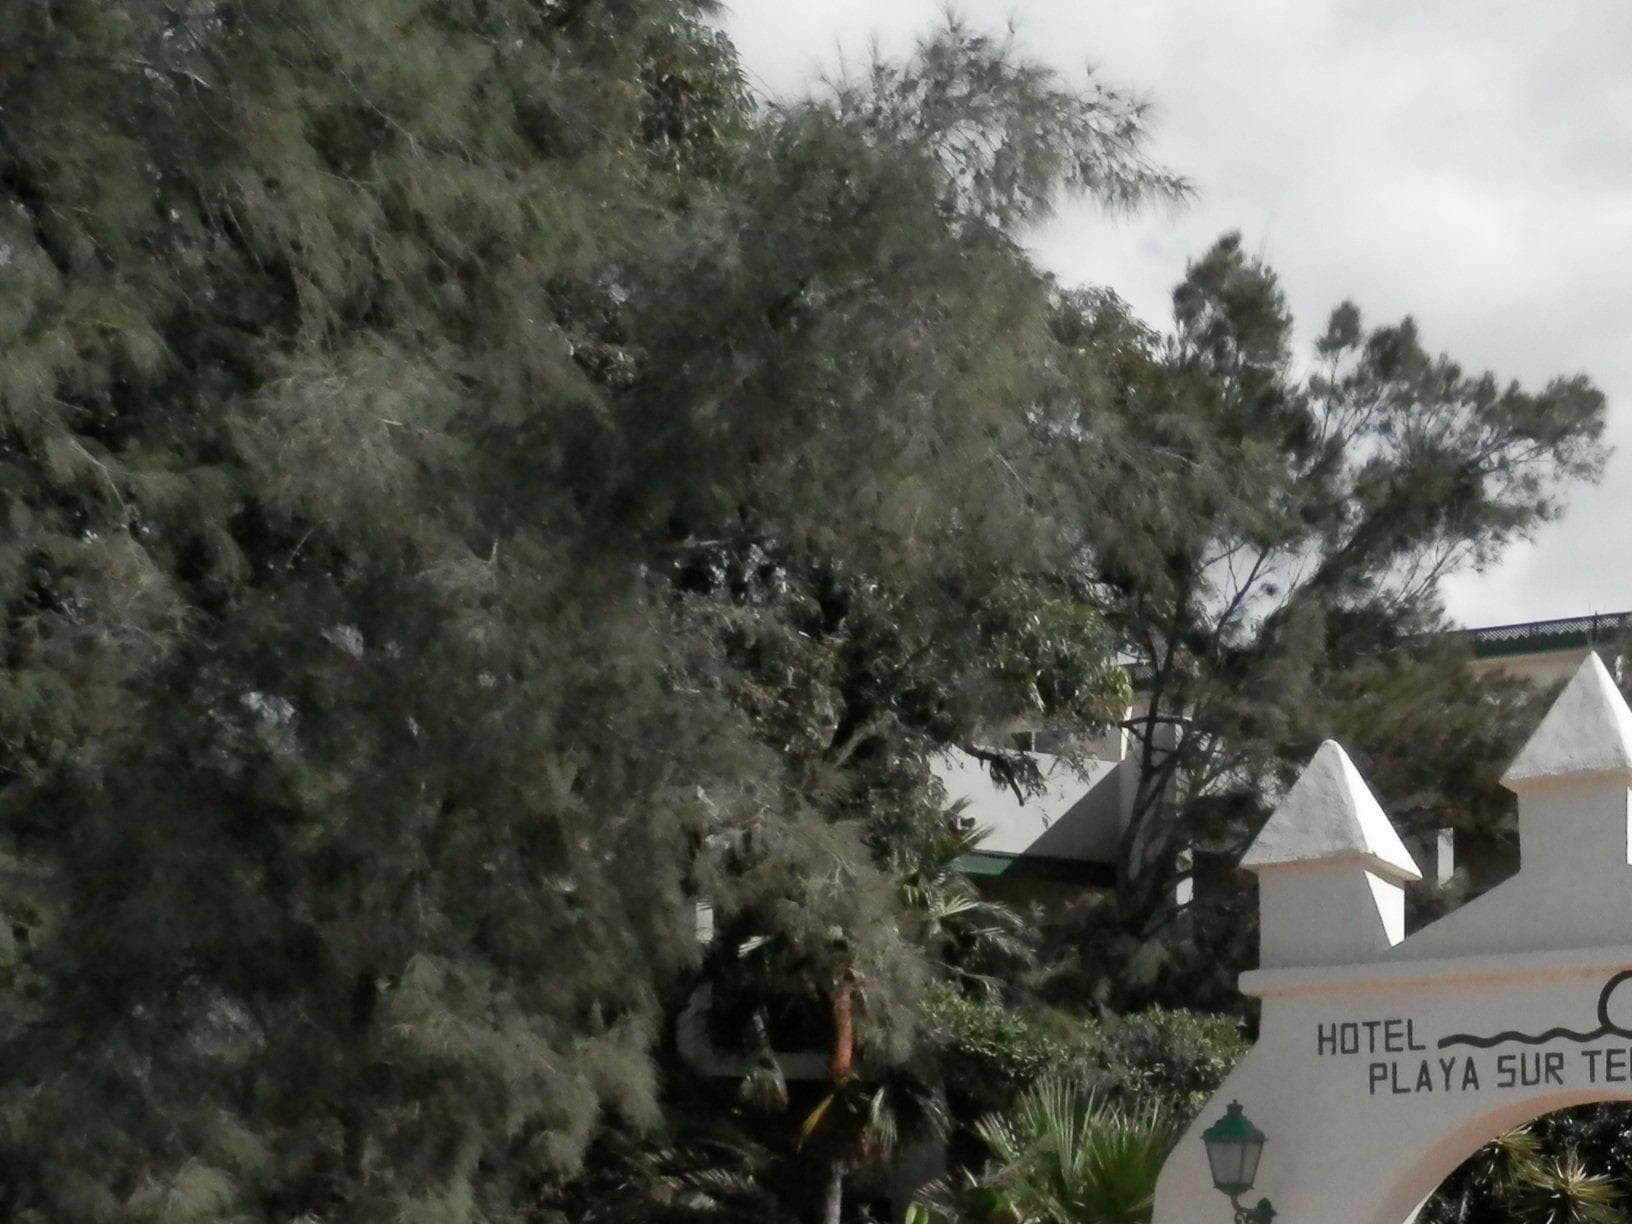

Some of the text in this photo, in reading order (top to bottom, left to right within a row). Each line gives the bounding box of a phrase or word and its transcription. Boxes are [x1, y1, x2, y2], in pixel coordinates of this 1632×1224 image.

[1317, 1019, 1426, 1055] HOTEL
[1368, 1056, 1480, 1095] PLAYA
[1496, 1052, 1564, 1088] SUR
